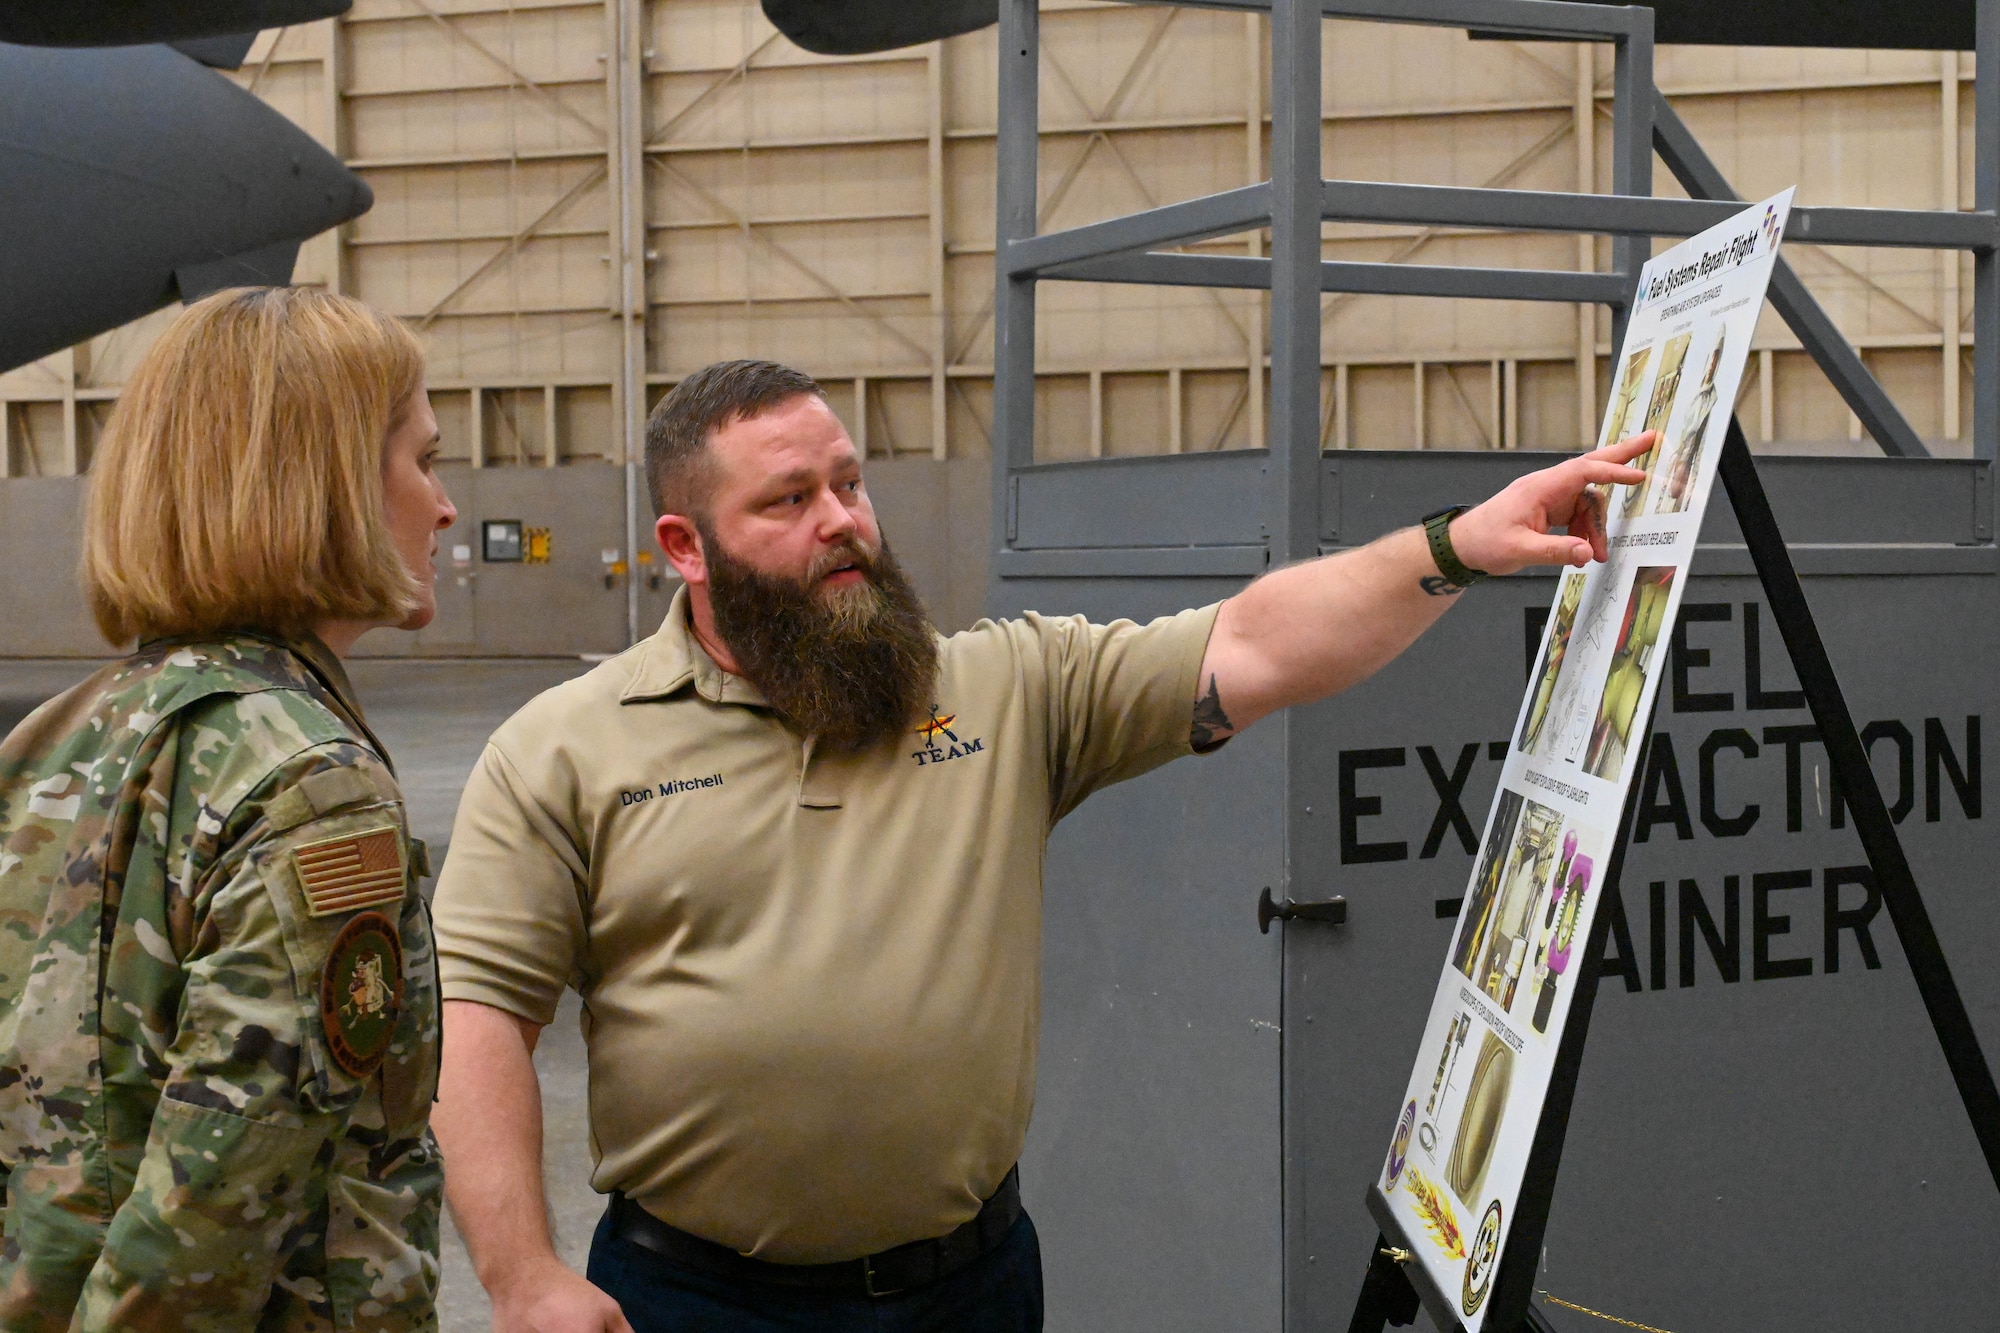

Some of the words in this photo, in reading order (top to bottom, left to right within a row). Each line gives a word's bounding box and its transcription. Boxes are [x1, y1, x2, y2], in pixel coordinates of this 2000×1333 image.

[1648, 271, 1667, 301] Fuel
[1665, 262, 1698, 297] Systems
[1698, 242, 1729, 279] Repair
[1727, 229, 1758, 266] Flight
[1524, 602, 1805, 713] EL
[621, 790, 654, 807] Don
[659, 773, 724, 798] Mitchell
[911, 737, 985, 766] TEAM
[1338, 715, 1982, 865] EXACTON
[1435, 865, 1882, 993] AINER
